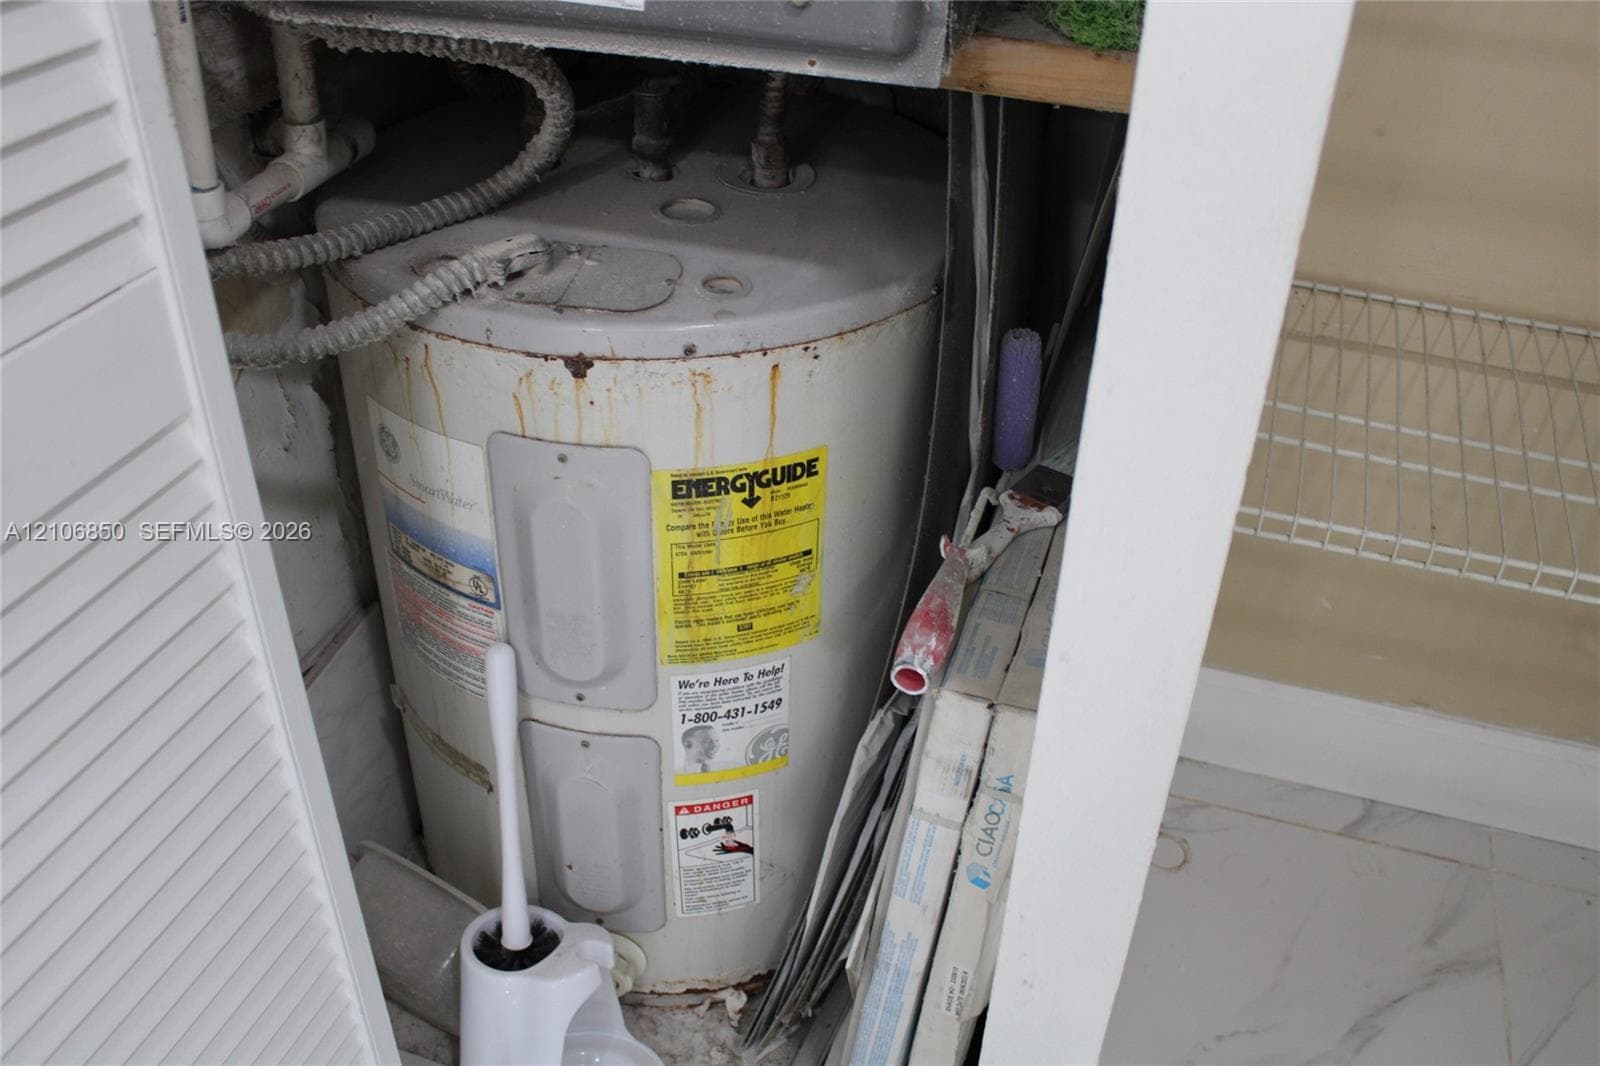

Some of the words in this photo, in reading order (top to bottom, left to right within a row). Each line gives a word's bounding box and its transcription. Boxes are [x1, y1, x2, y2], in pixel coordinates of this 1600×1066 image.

[671, 457, 819, 502] ENERGYGUIDE
[666, 524, 696, 533] Compare
[698, 522, 710, 530] the
[737, 517, 749, 526] Use
[751, 515, 759, 523] of
[760, 512, 772, 521] this
[774, 508, 793, 518] Water
[696, 529, 710, 538] with
[736, 525, 758, 534] Before
[760, 522, 773, 530] You
[678, 679, 710, 690] We're
[713, 676, 739, 687] Here
[743, 671, 754, 682] To
[757, 663, 785, 679] Help!
[680, 697, 783, 725] 1-800-431-1549
[693, 798, 749, 813] DANGER
